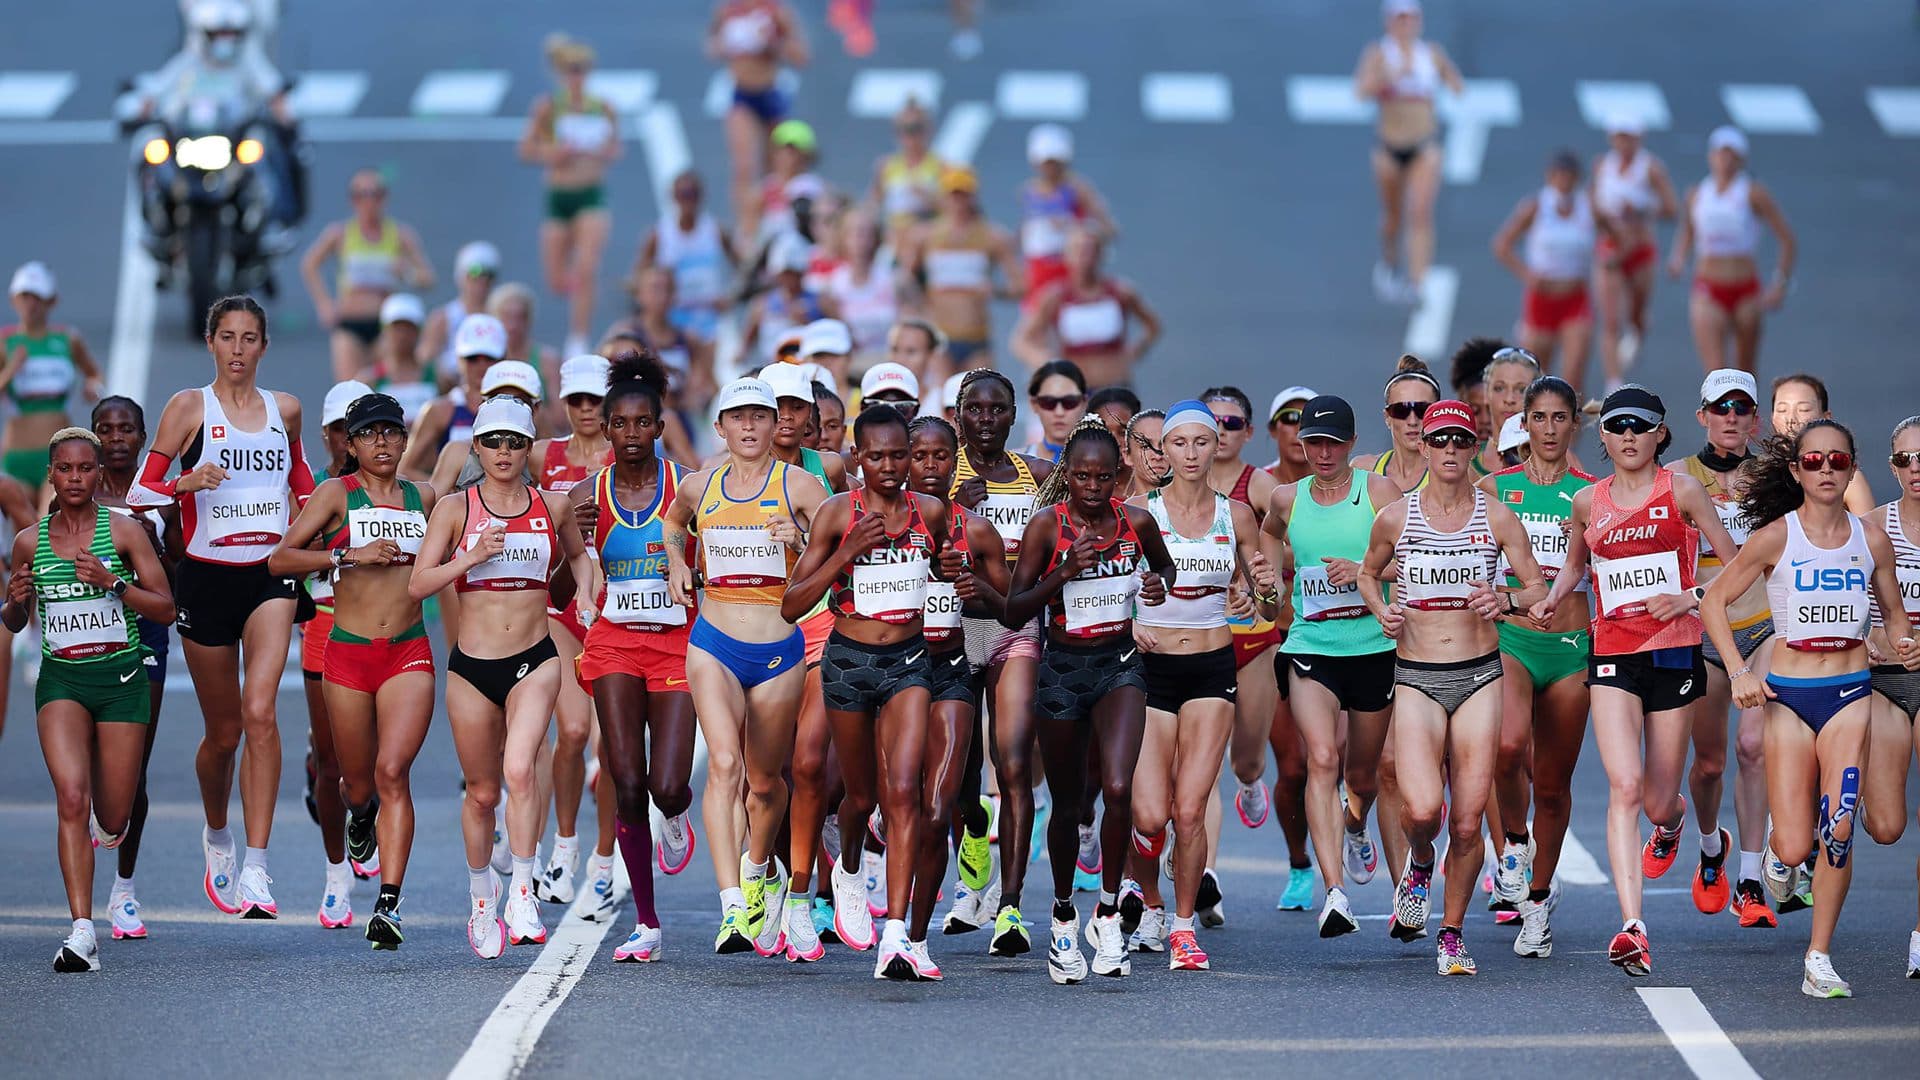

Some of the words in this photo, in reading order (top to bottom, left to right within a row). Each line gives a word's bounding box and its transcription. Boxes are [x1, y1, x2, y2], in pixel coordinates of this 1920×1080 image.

[878, 373, 904, 381] USA
[734, 385, 763, 393] UKRAINE
[1432, 407, 1471, 422] CANADA
[220, 449, 284, 471] SUISSE
[212, 502, 281, 519] SCHLUMPF
[357, 521, 425, 538] TORRES
[1604, 524, 1658, 545] JAPAN
[500, 548, 539, 562] YAMA
[709, 545, 779, 558] PROKOFYEVA
[1608, 566, 1667, 592] MAEDA
[1795, 569, 1867, 592] USA
[616, 592, 674, 610] WELDU
[48, 608, 122, 633] KHATALA
[1798, 605, 1859, 624] SEIDEL
